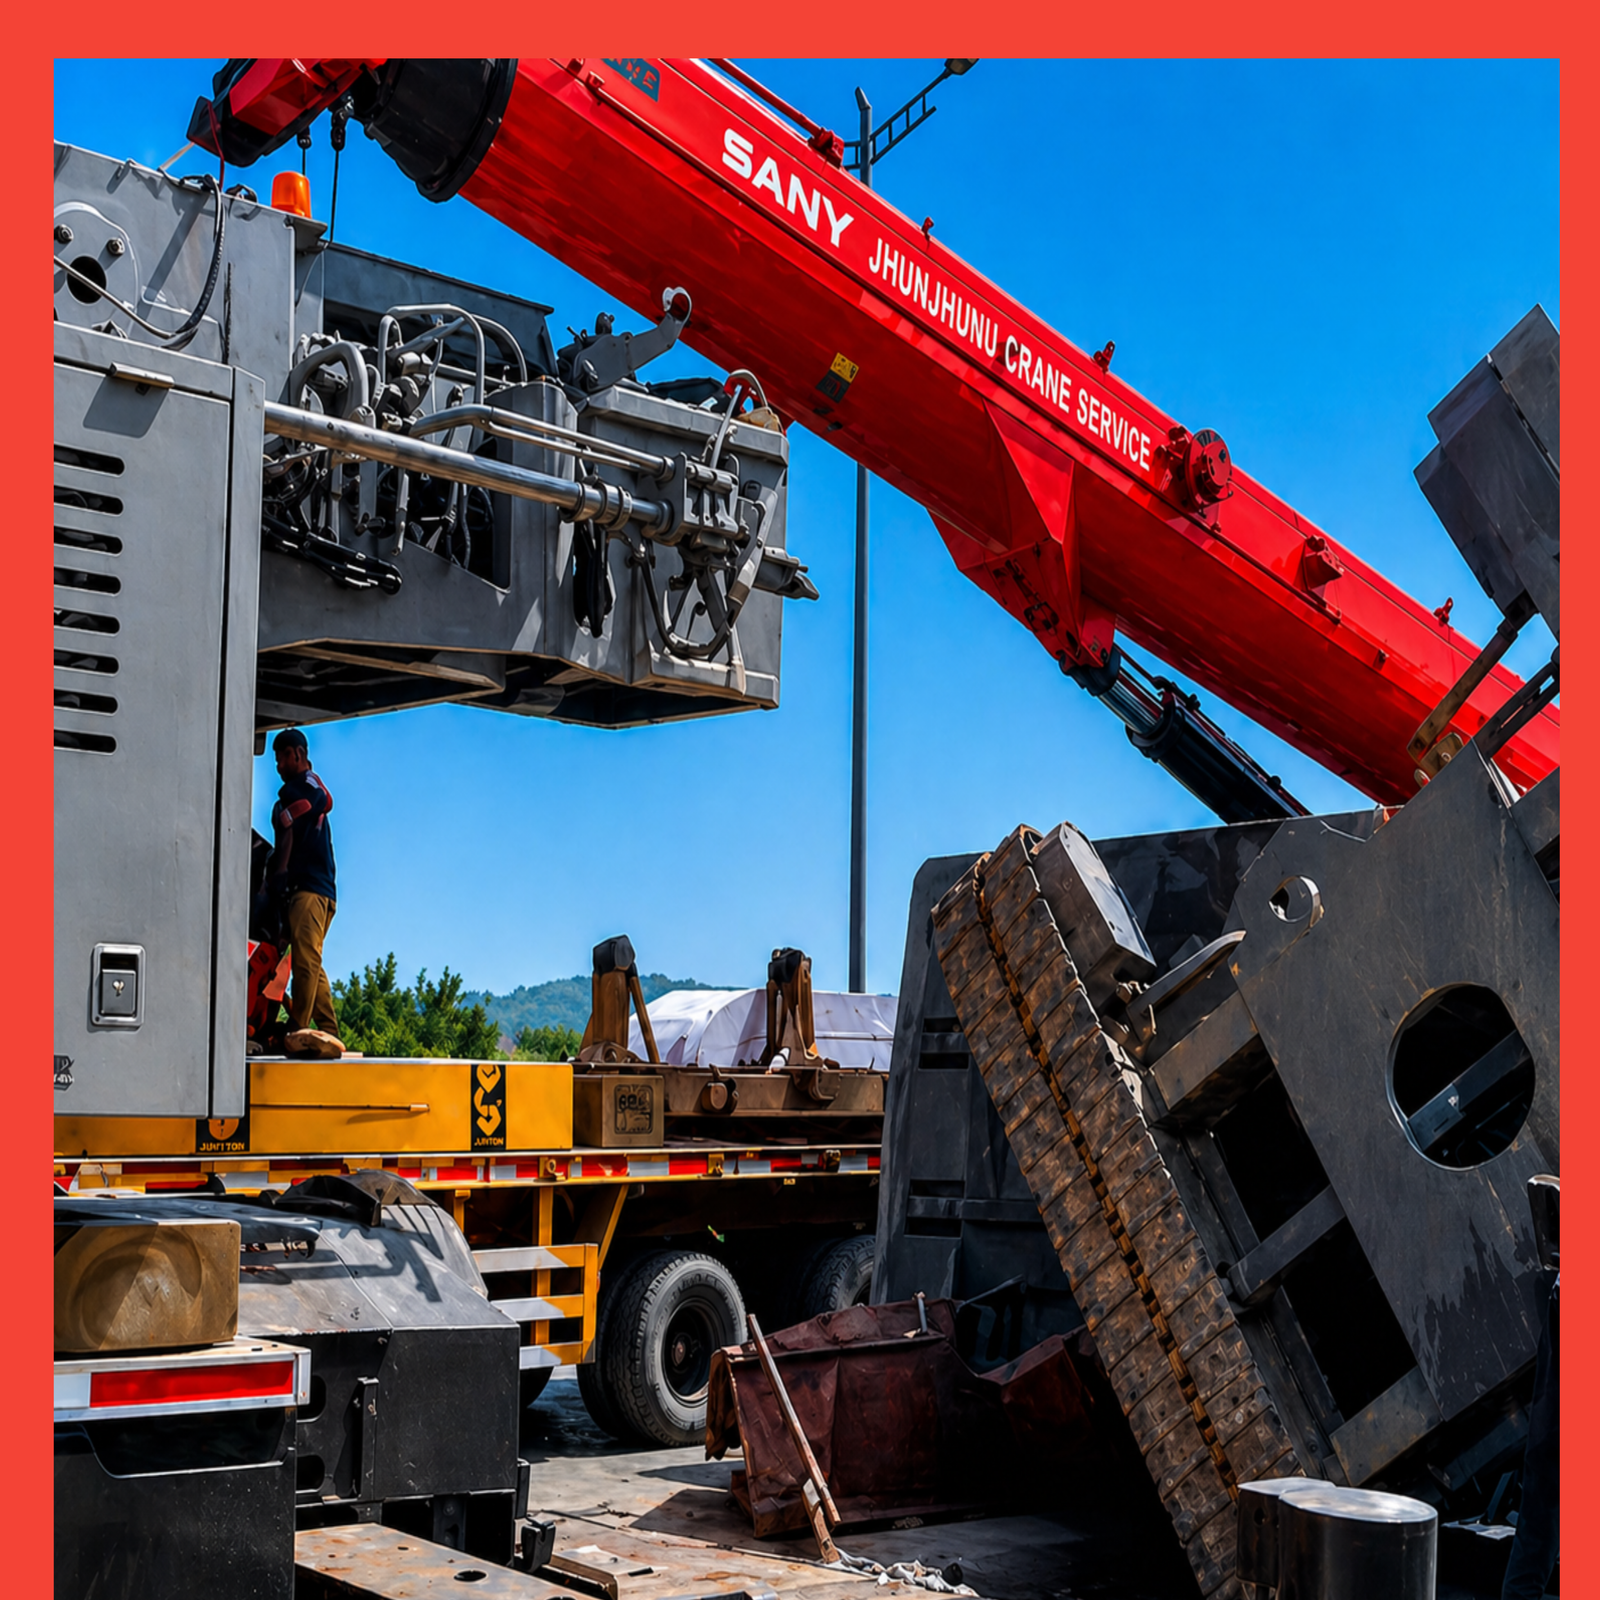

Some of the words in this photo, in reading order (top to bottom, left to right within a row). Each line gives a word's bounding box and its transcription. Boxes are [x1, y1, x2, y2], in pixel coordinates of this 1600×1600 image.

[722, 128, 854, 248] SANY
[868, 237, 998, 358] JHUNJHUNU
[1004, 335, 1072, 414] CRANE
[1076, 388, 1151, 471] SERVICE
